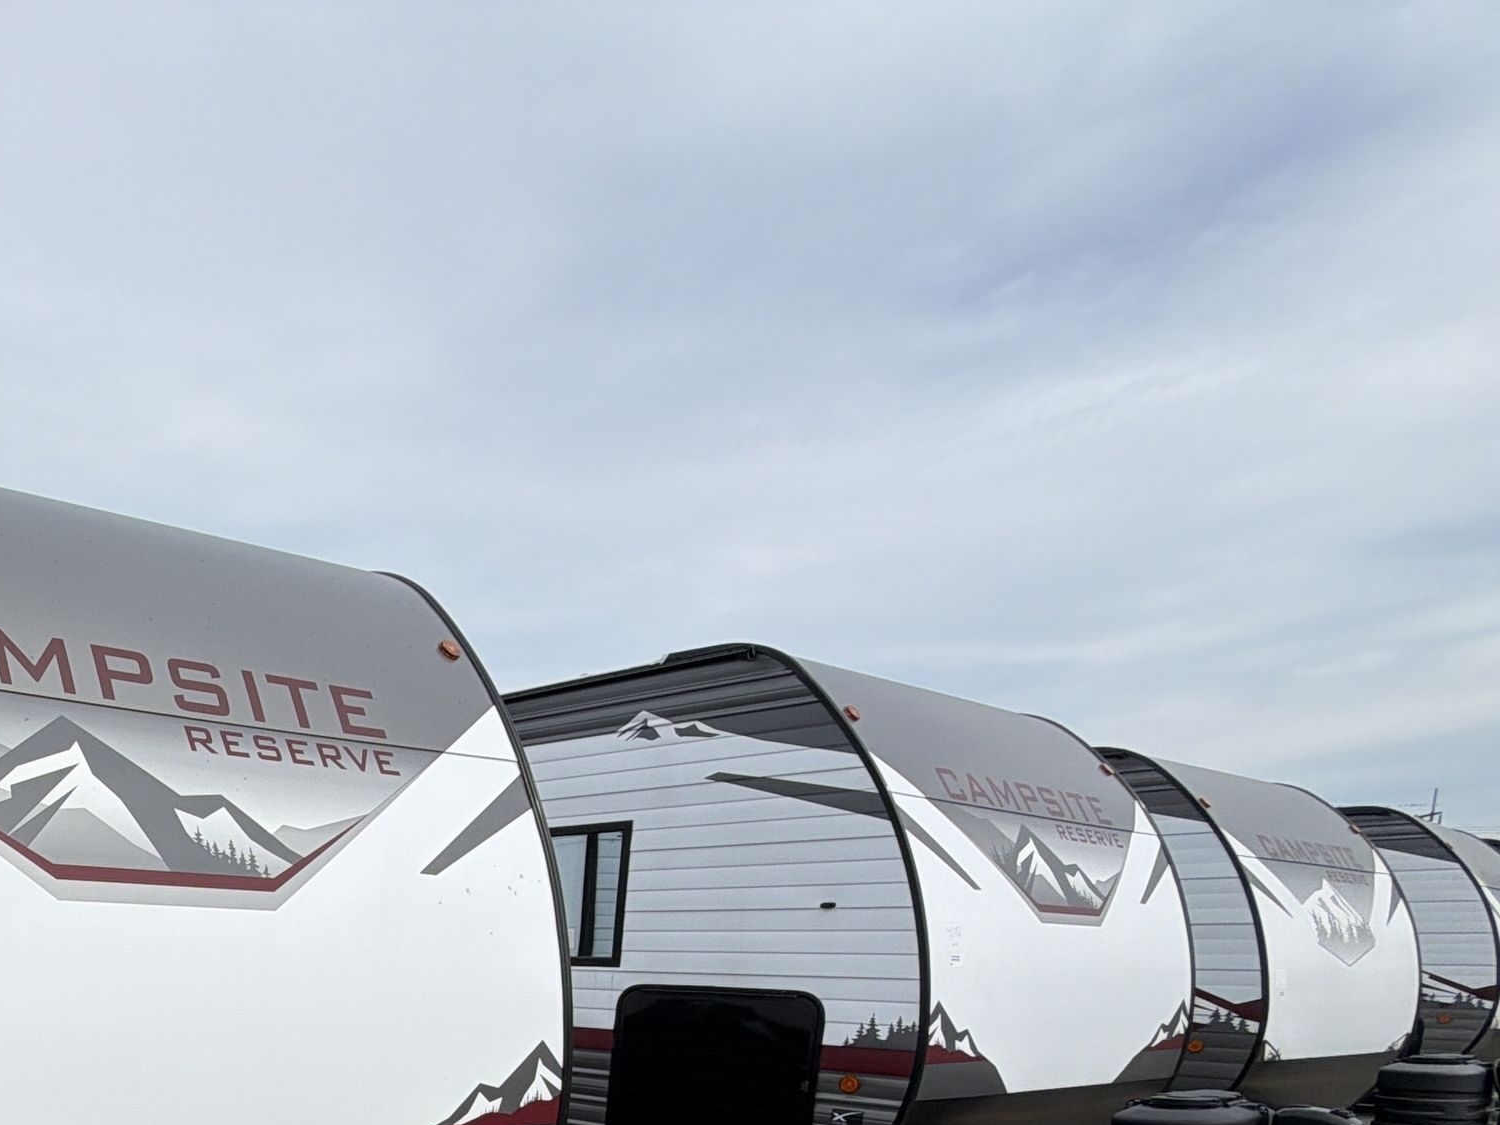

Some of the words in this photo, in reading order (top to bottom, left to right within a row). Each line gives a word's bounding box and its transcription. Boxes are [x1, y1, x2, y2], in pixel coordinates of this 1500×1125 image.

[183, 724, 403, 776] RESERVE
[935, 766, 1113, 827] CAMPSITE
[1055, 823, 1125, 849] RESERVE
[1255, 833, 1364, 870] CAMPSITE
